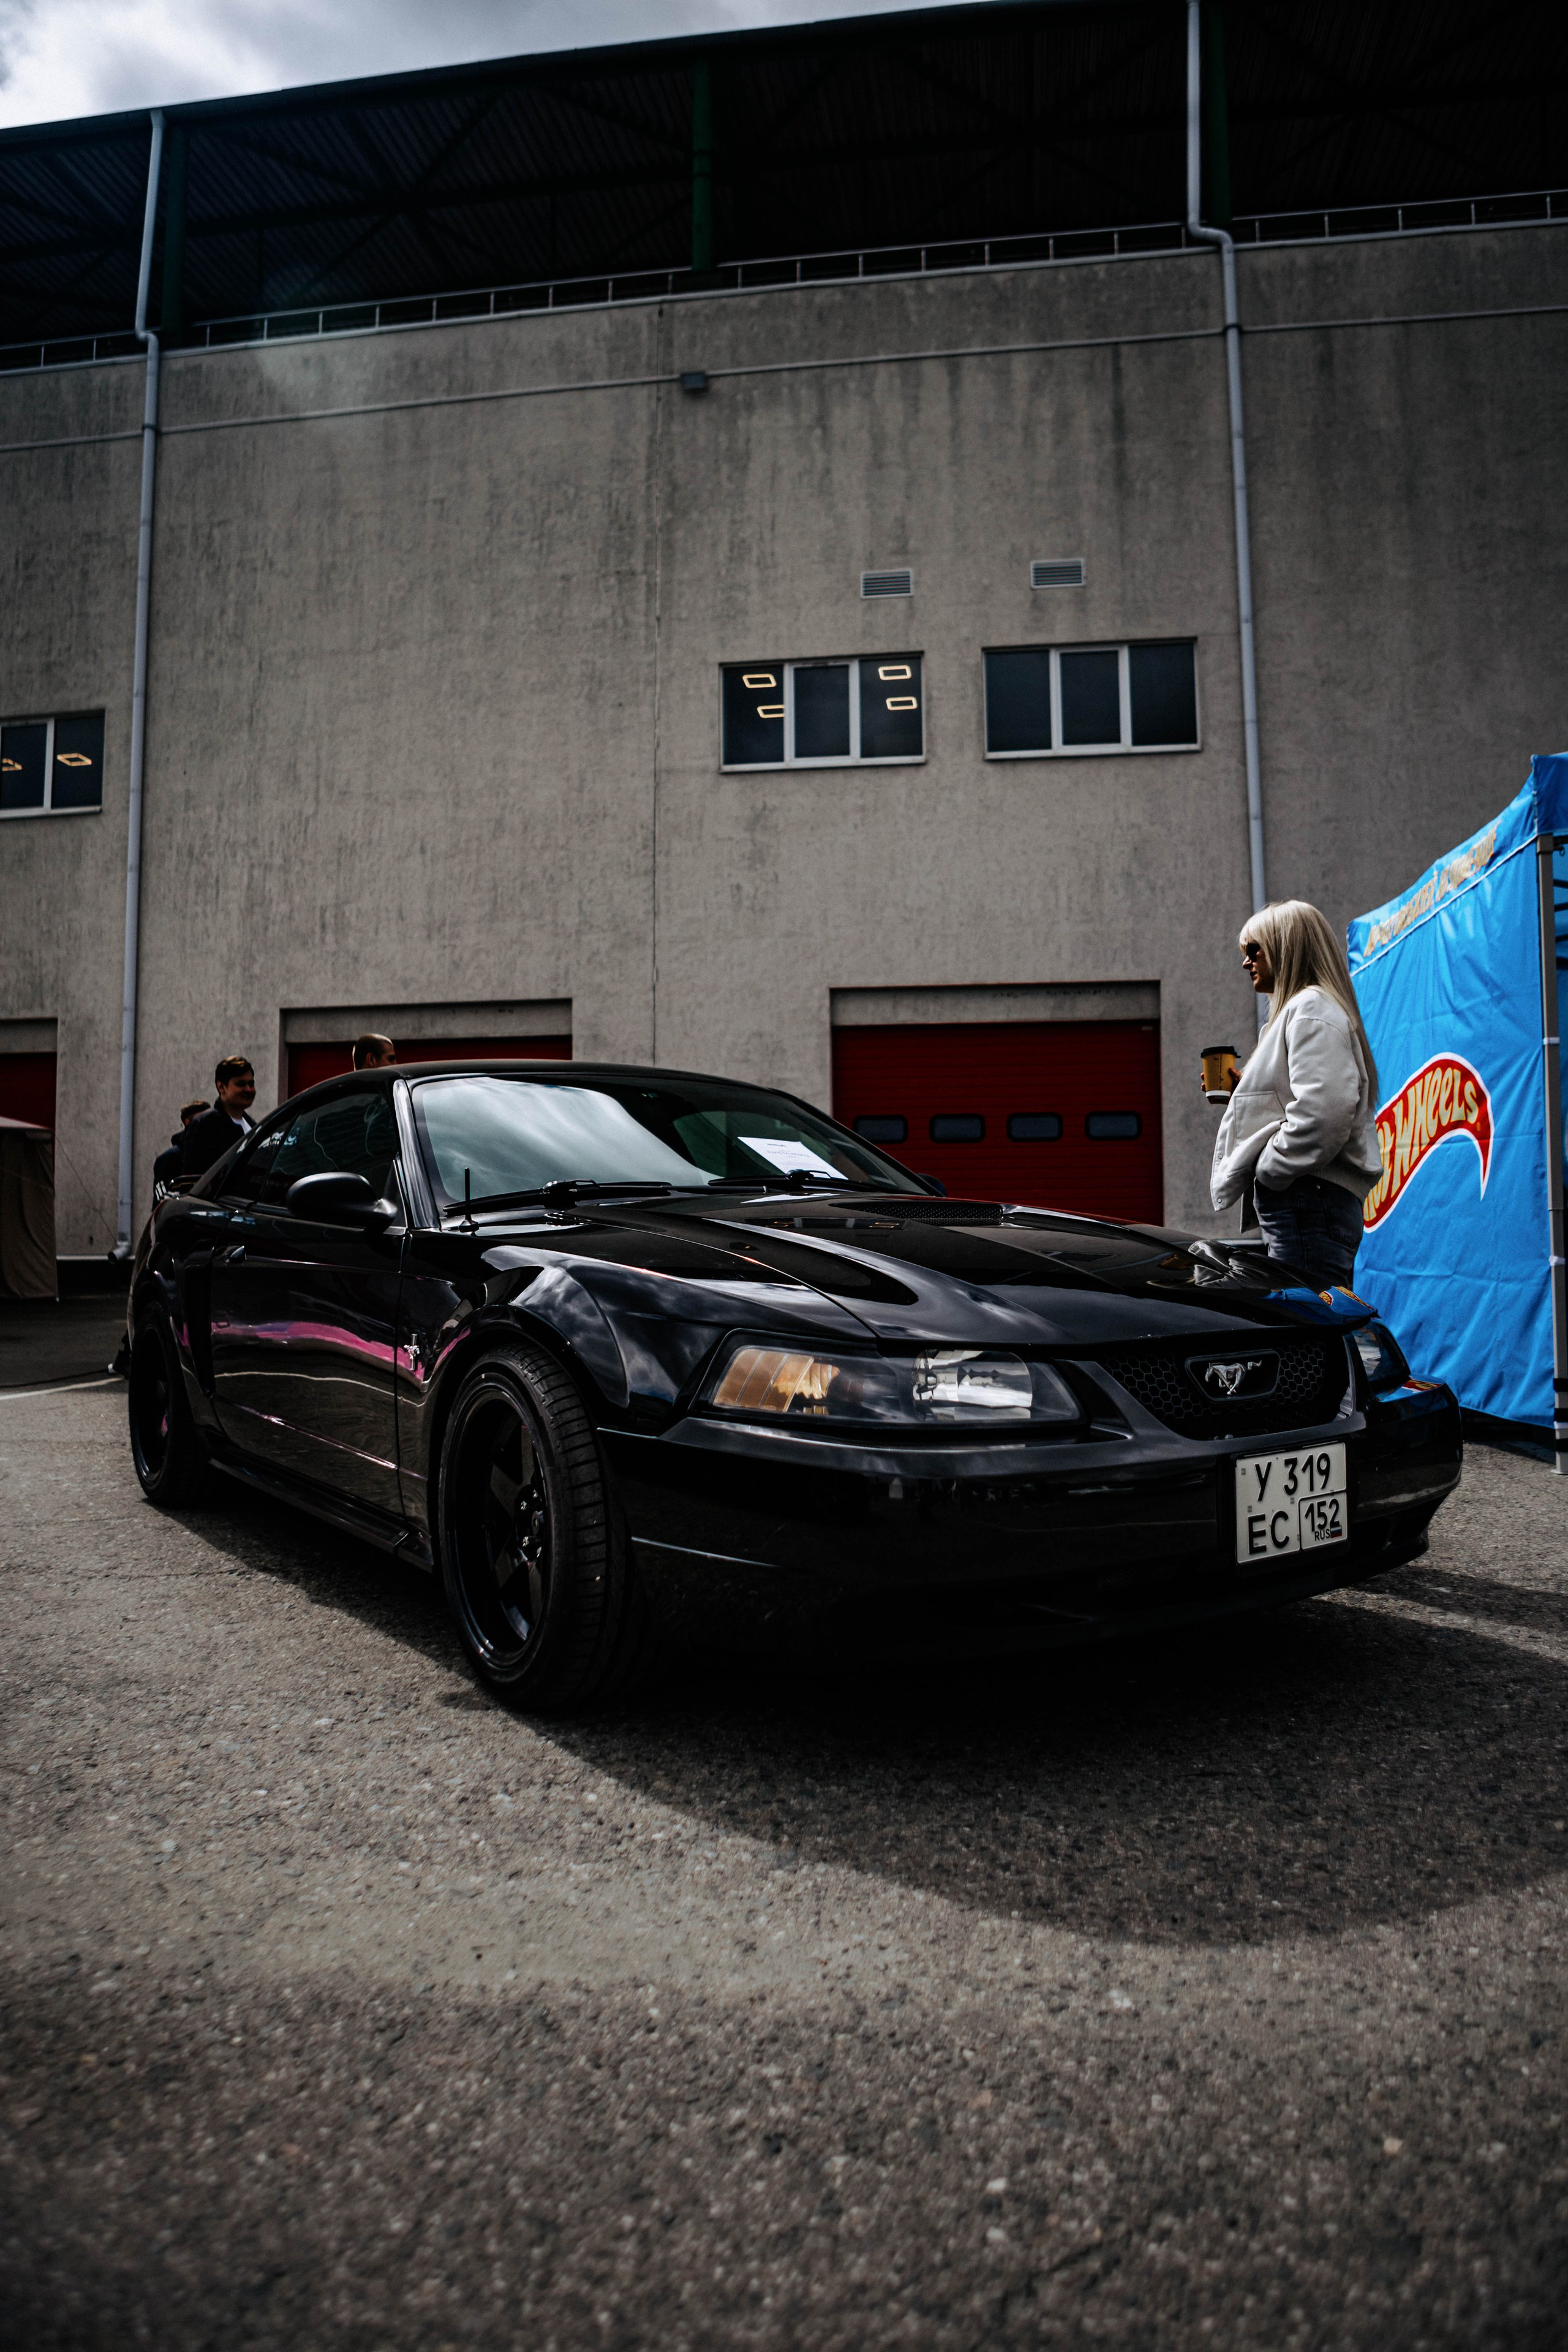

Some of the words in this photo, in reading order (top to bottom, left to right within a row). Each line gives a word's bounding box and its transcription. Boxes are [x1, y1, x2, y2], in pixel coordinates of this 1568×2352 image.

[1284, 1452, 1330, 1495] 319
[1305, 1498, 1340, 1532] 152
[1314, 1528, 1330, 1542] RUS
